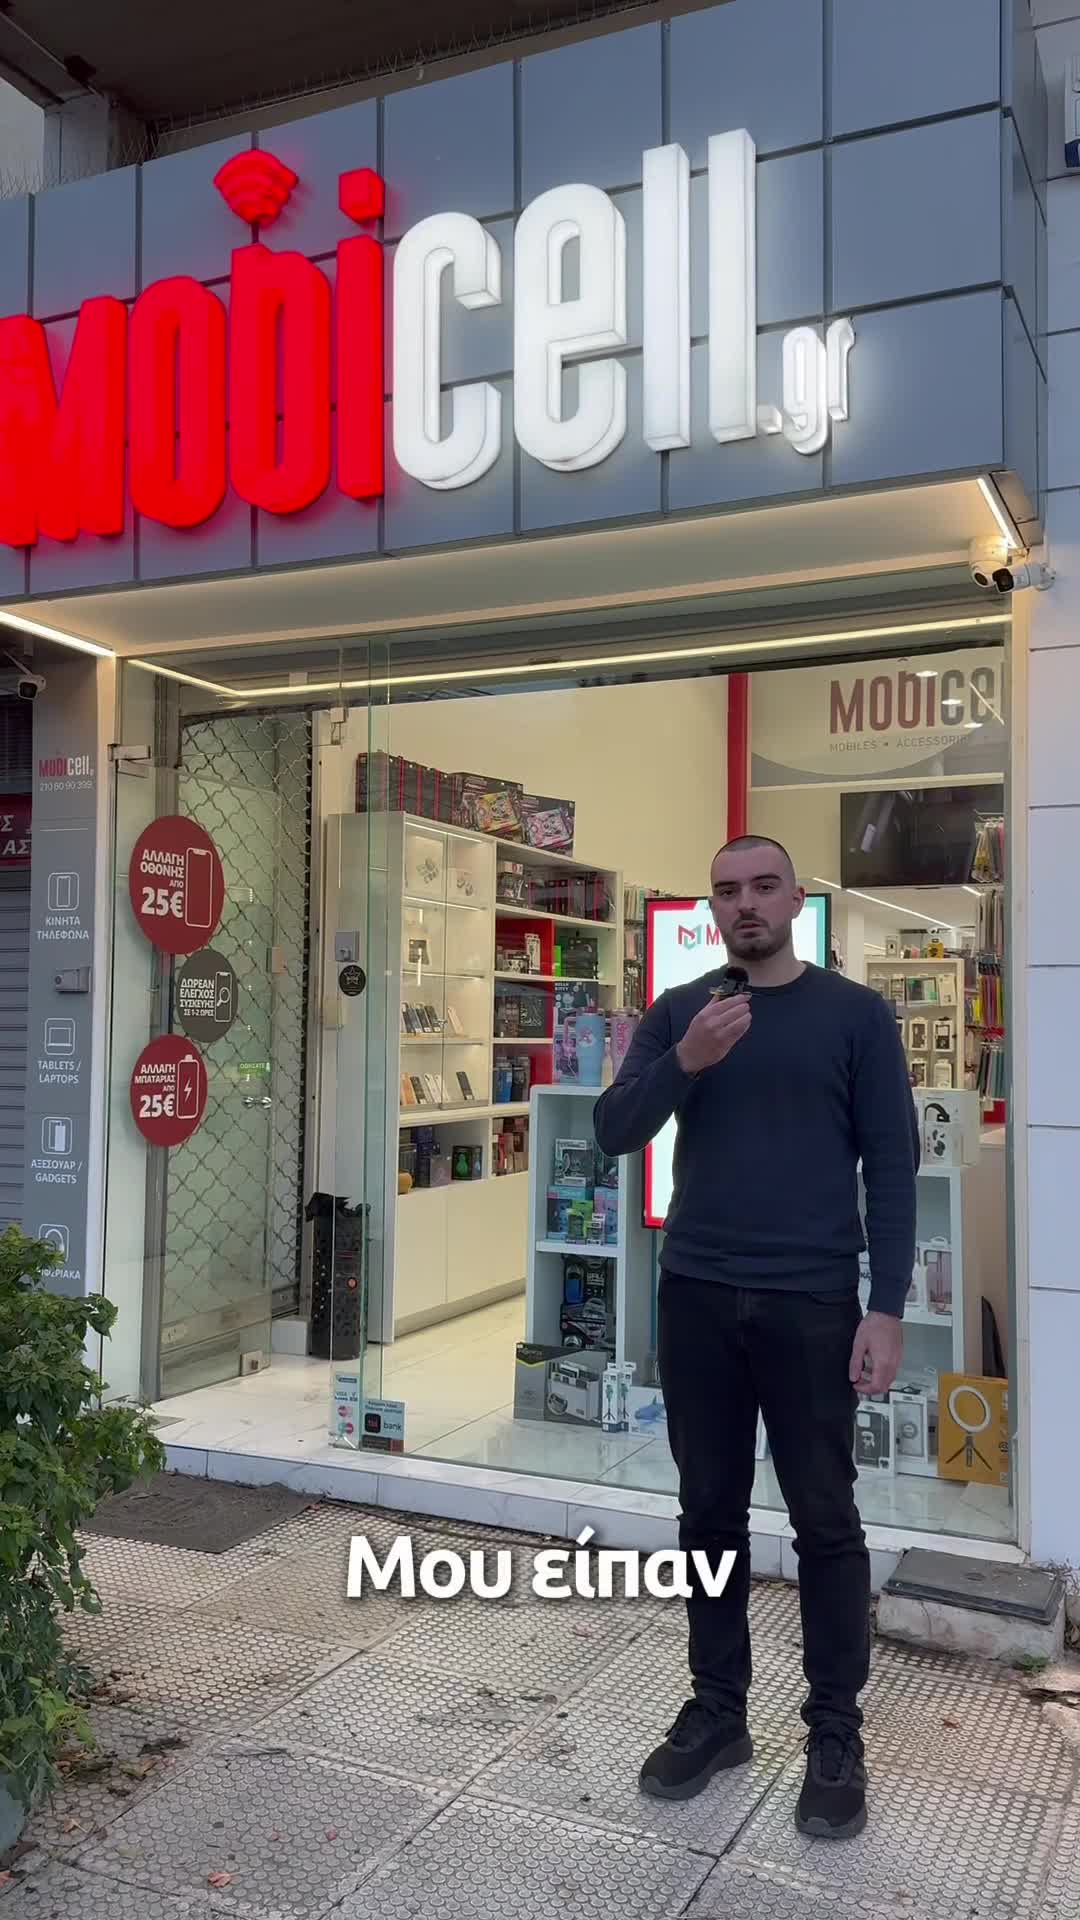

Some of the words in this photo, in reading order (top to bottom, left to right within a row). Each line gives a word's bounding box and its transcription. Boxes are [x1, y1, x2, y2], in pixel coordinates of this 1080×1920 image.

[829, 740, 878, 752] MOBILES
[142, 848, 185, 866] ΑΛΛΑΓΗ
[140, 861, 185, 879] ΟΘΟΝΗΣ
[169, 879, 184, 888] ΑΠΟ
[141, 886, 184, 918] 25€
[45, 917, 80, 926] ΚΙΝΗΤΑ
[36, 930, 89, 940] ΤΗΛΕΦΩΝΑ
[181, 978, 215, 989] ΔΩΡΕΑΝ
[180, 988, 215, 999] ΕΛΕΓΧΟΣ
[180, 999, 215, 1008] ΣΥΣΚΕΥΗΣ
[37, 1060, 74, 1071] TABLETS
[140, 1063, 176, 1075] ΑΛΛΑΓΗ
[39, 1074, 79, 1085] LAPTOPS
[134, 1074, 176, 1084] ΜΠΑΤΑΡΙΑΣ
[139, 1094, 176, 1118] 25€
[31, 1159, 75, 1171] ΑΞΕΣΟΥΑΡ
[35, 1173, 77, 1184] GADGETS
[383, 1421, 402, 1431] bank
